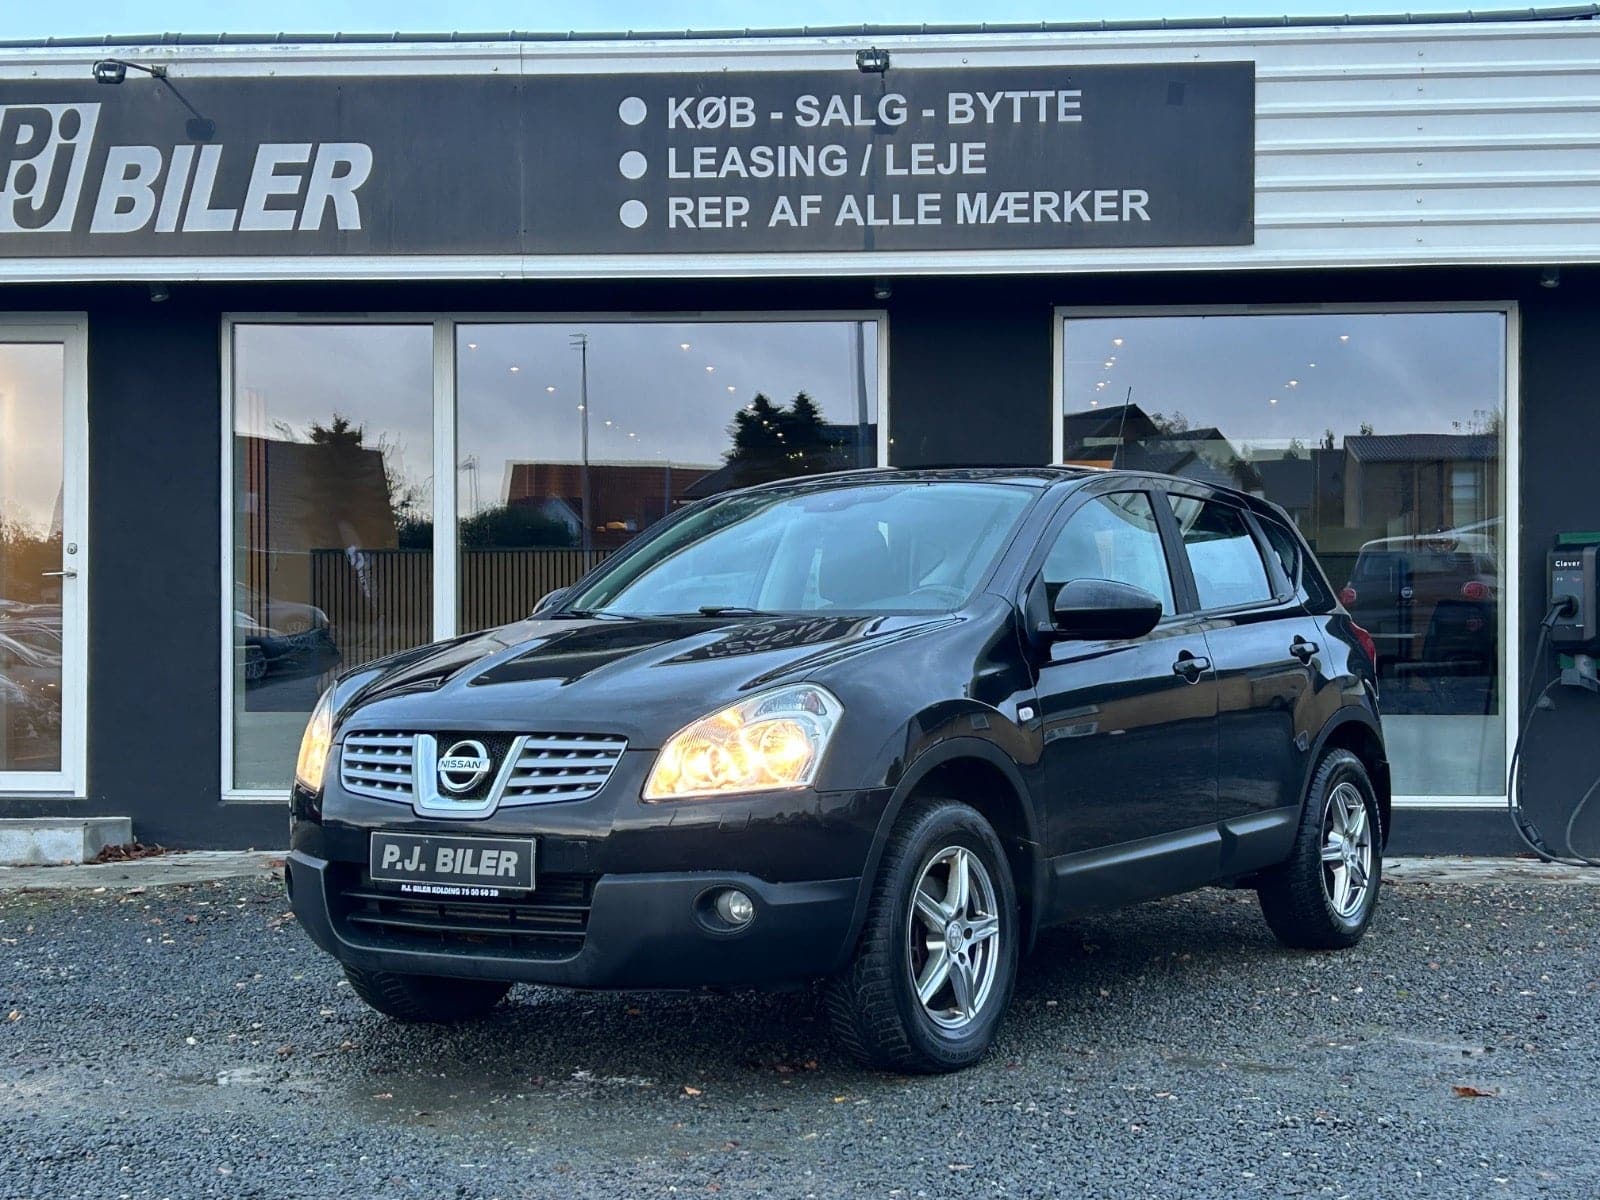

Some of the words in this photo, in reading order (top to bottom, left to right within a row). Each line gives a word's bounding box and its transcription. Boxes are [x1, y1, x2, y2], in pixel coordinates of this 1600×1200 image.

[669, 95, 756, 130] KØB
[795, 93, 908, 128] SALG
[948, 90, 1083, 125] BYTTE
[668, 144, 848, 179] LEASING
[886, 142, 987, 176] LEJE
[90, 143, 373, 233] BILER
[668, 196, 749, 229] REP.
[768, 195, 823, 228] AF
[835, 193, 942, 227] ALLE
[957, 190, 1151, 225] MÆRKER
[440, 760, 482, 769] NISSAN
[381, 844, 426, 873] P.J.
[435, 848, 519, 877] BILER
[413, 885, 431, 894] BILER
[431, 886, 460, 895] KOLDING
